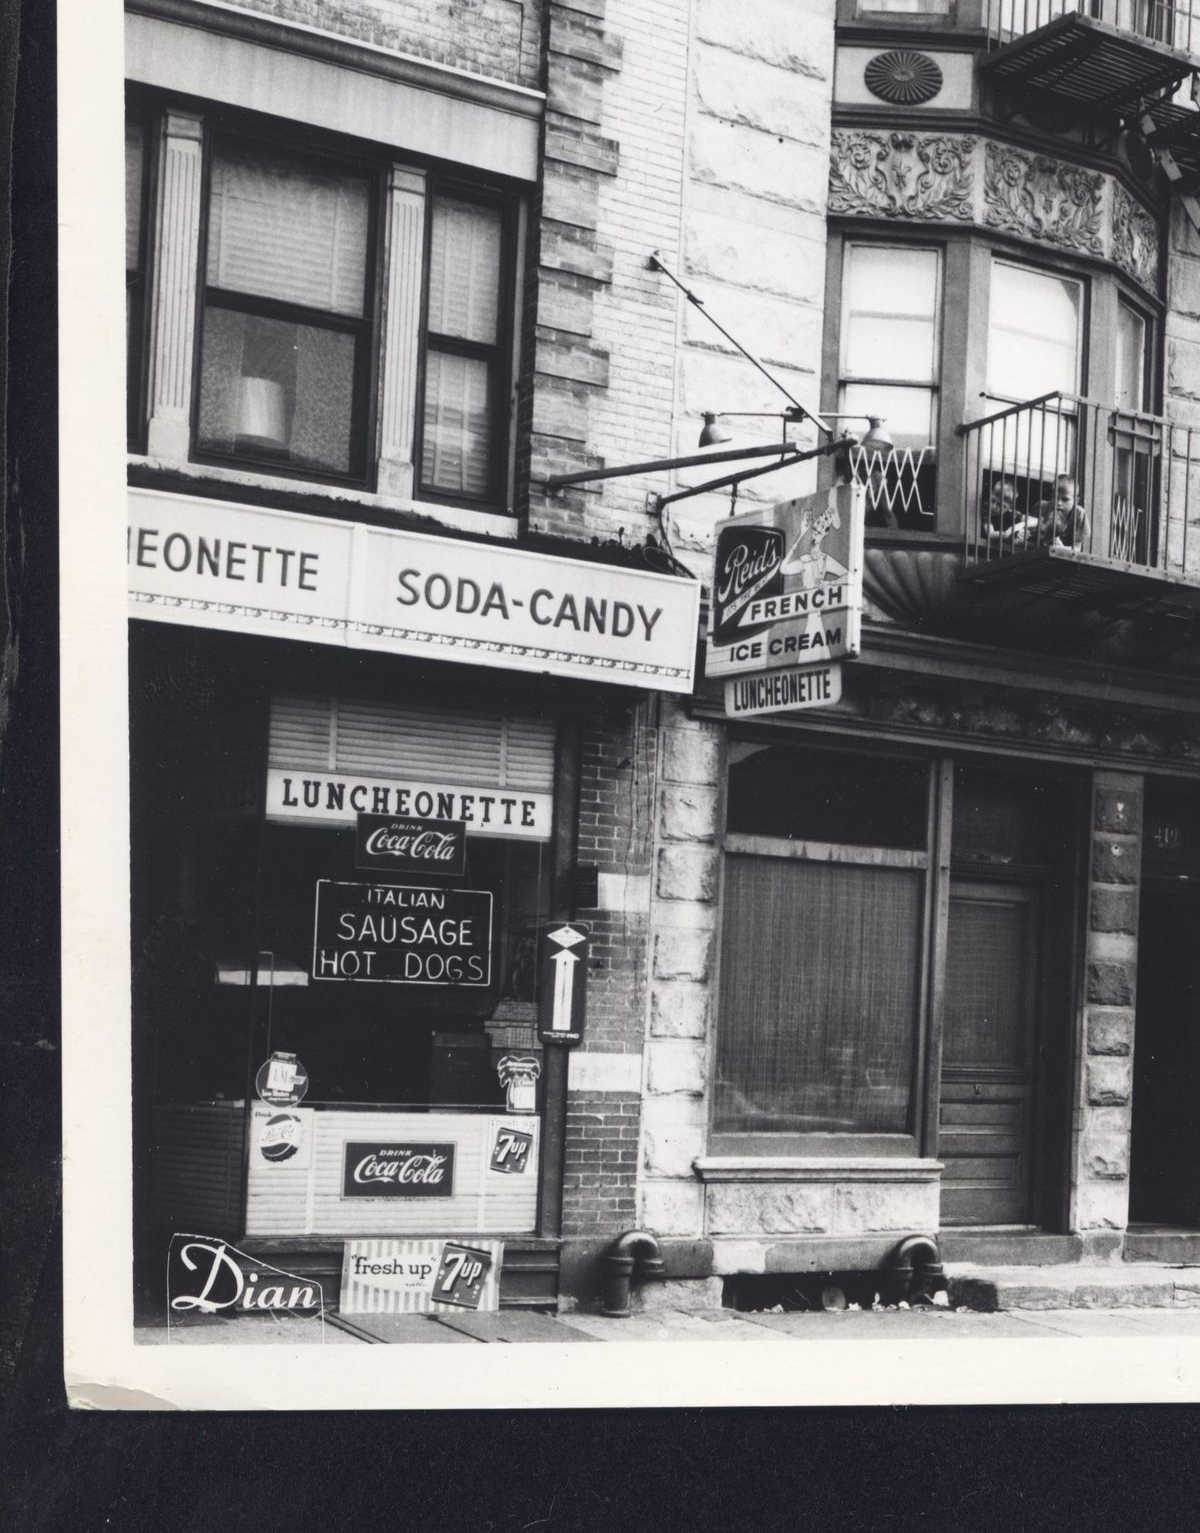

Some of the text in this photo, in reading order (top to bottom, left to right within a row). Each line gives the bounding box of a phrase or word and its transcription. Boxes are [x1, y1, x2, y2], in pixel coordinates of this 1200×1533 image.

[128, 527, 319, 592] EONETTE
[718, 539, 781, 603] Reid's
[396, 568, 663, 642] SODA-CANDY
[751, 586, 843, 621] FRENCH
[730, 628, 842, 662] ICE CREAM
[734, 669, 831, 711] LUNCHEONETTE
[282, 778, 536, 827] LUNCHEONETTE
[391, 823, 424, 832] DRINK
[367, 888, 445, 910] ITALIAN
[337, 913, 474, 946] SAUSAGE
[321, 949, 484, 981] HOT DOGS
[379, 1149, 413, 1157] DRINK
